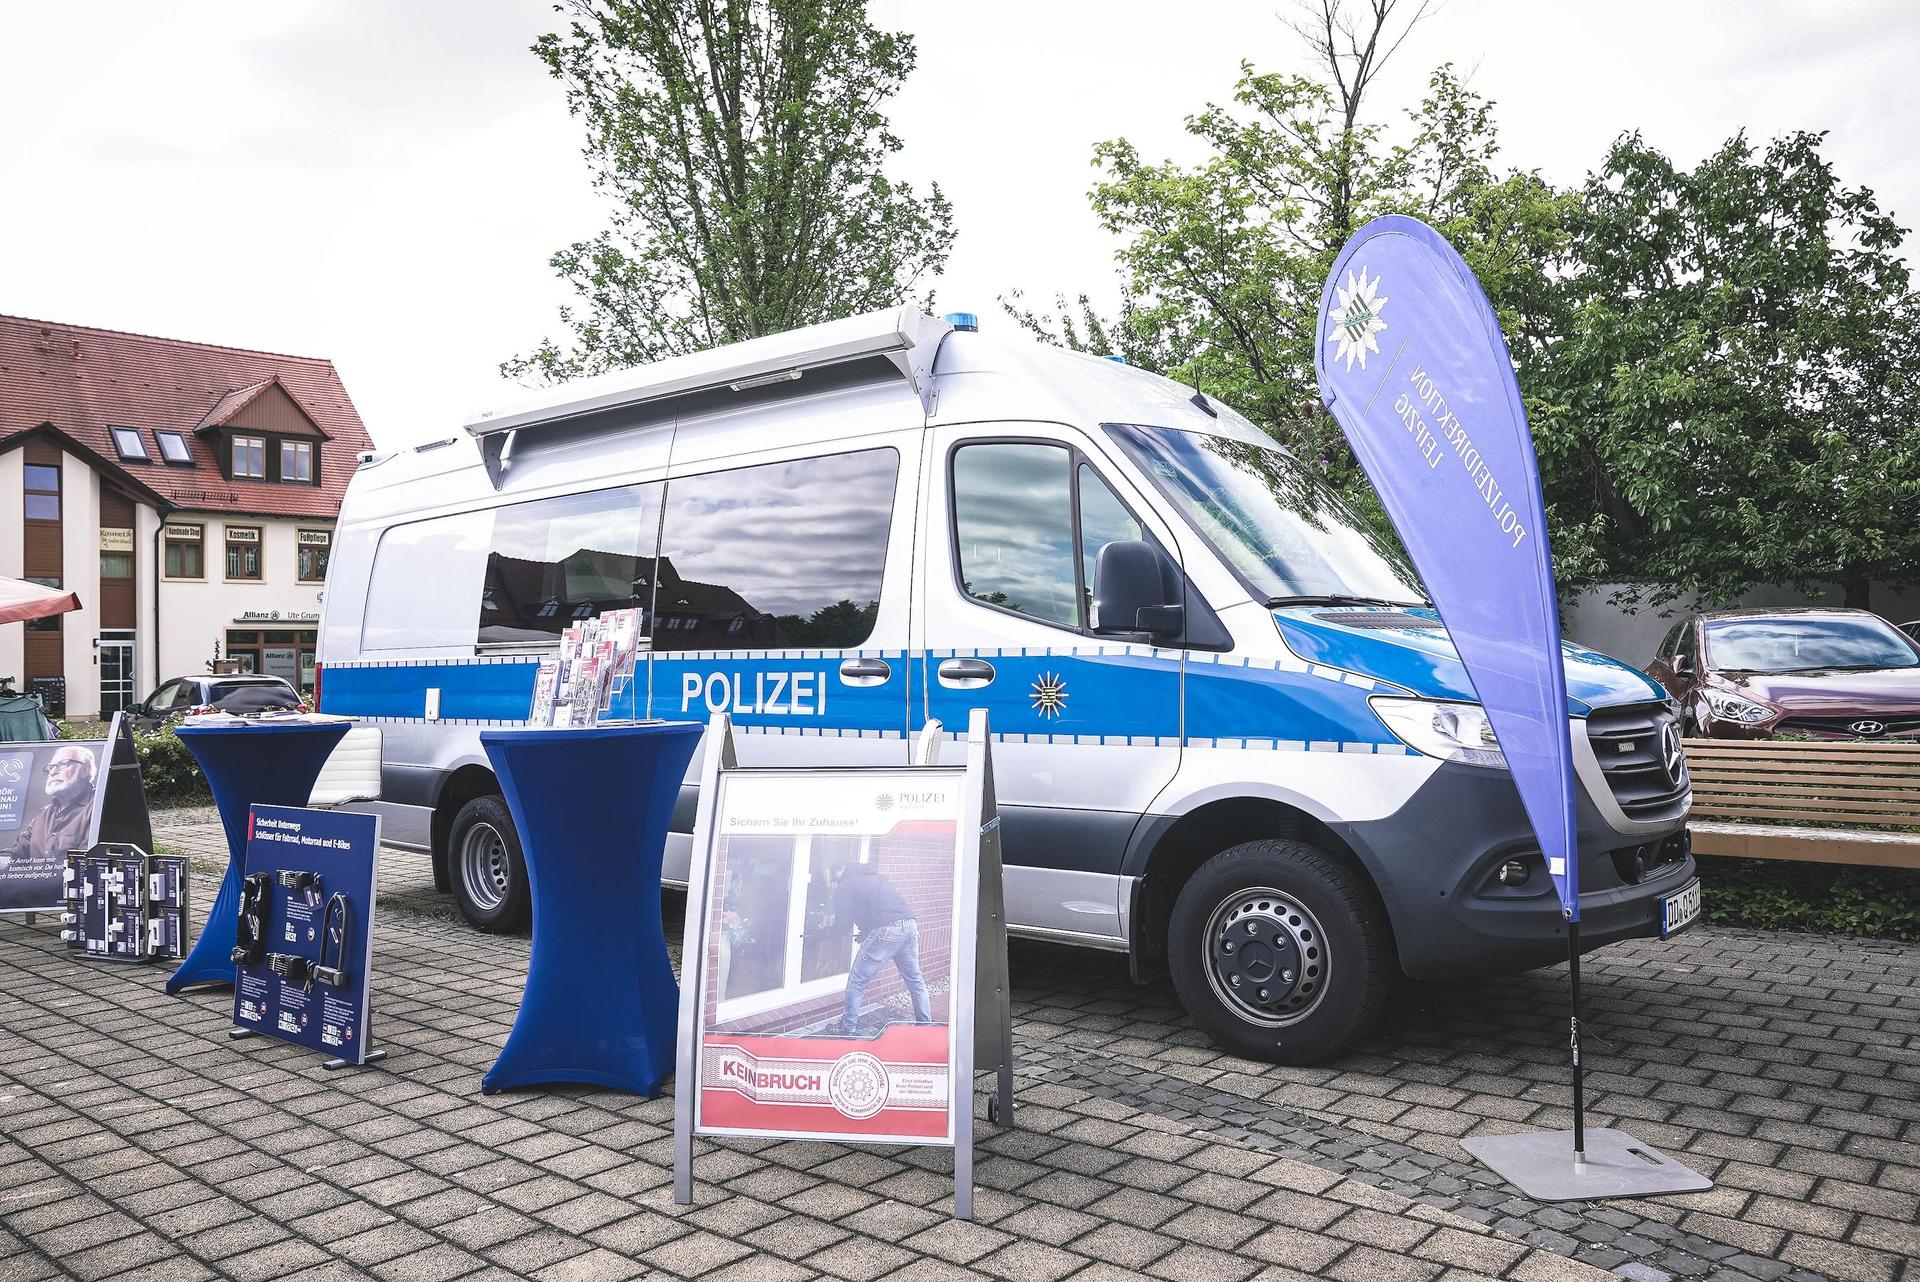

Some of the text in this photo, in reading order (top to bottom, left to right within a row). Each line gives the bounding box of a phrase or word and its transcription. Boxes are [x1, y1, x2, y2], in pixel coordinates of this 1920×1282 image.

[168, 526, 200, 537] Handmade Shop
[229, 529, 256, 540] Kosmetik
[243, 611, 269, 619] Allianz
[287, 611, 300, 619] Ute
[681, 671, 826, 716] POLIZEI
[0, 795, 18, 803] NAU
[899, 791, 945, 803] POLIZEI
[256, 817, 277, 828] Sicherheit
[729, 817, 859, 828] Sichern Sie Ihr Zuhause!
[301, 835, 322, 847] Motorrad
[322, 838, 332, 848] und
[332, 839, 351, 850] E-Bikes
